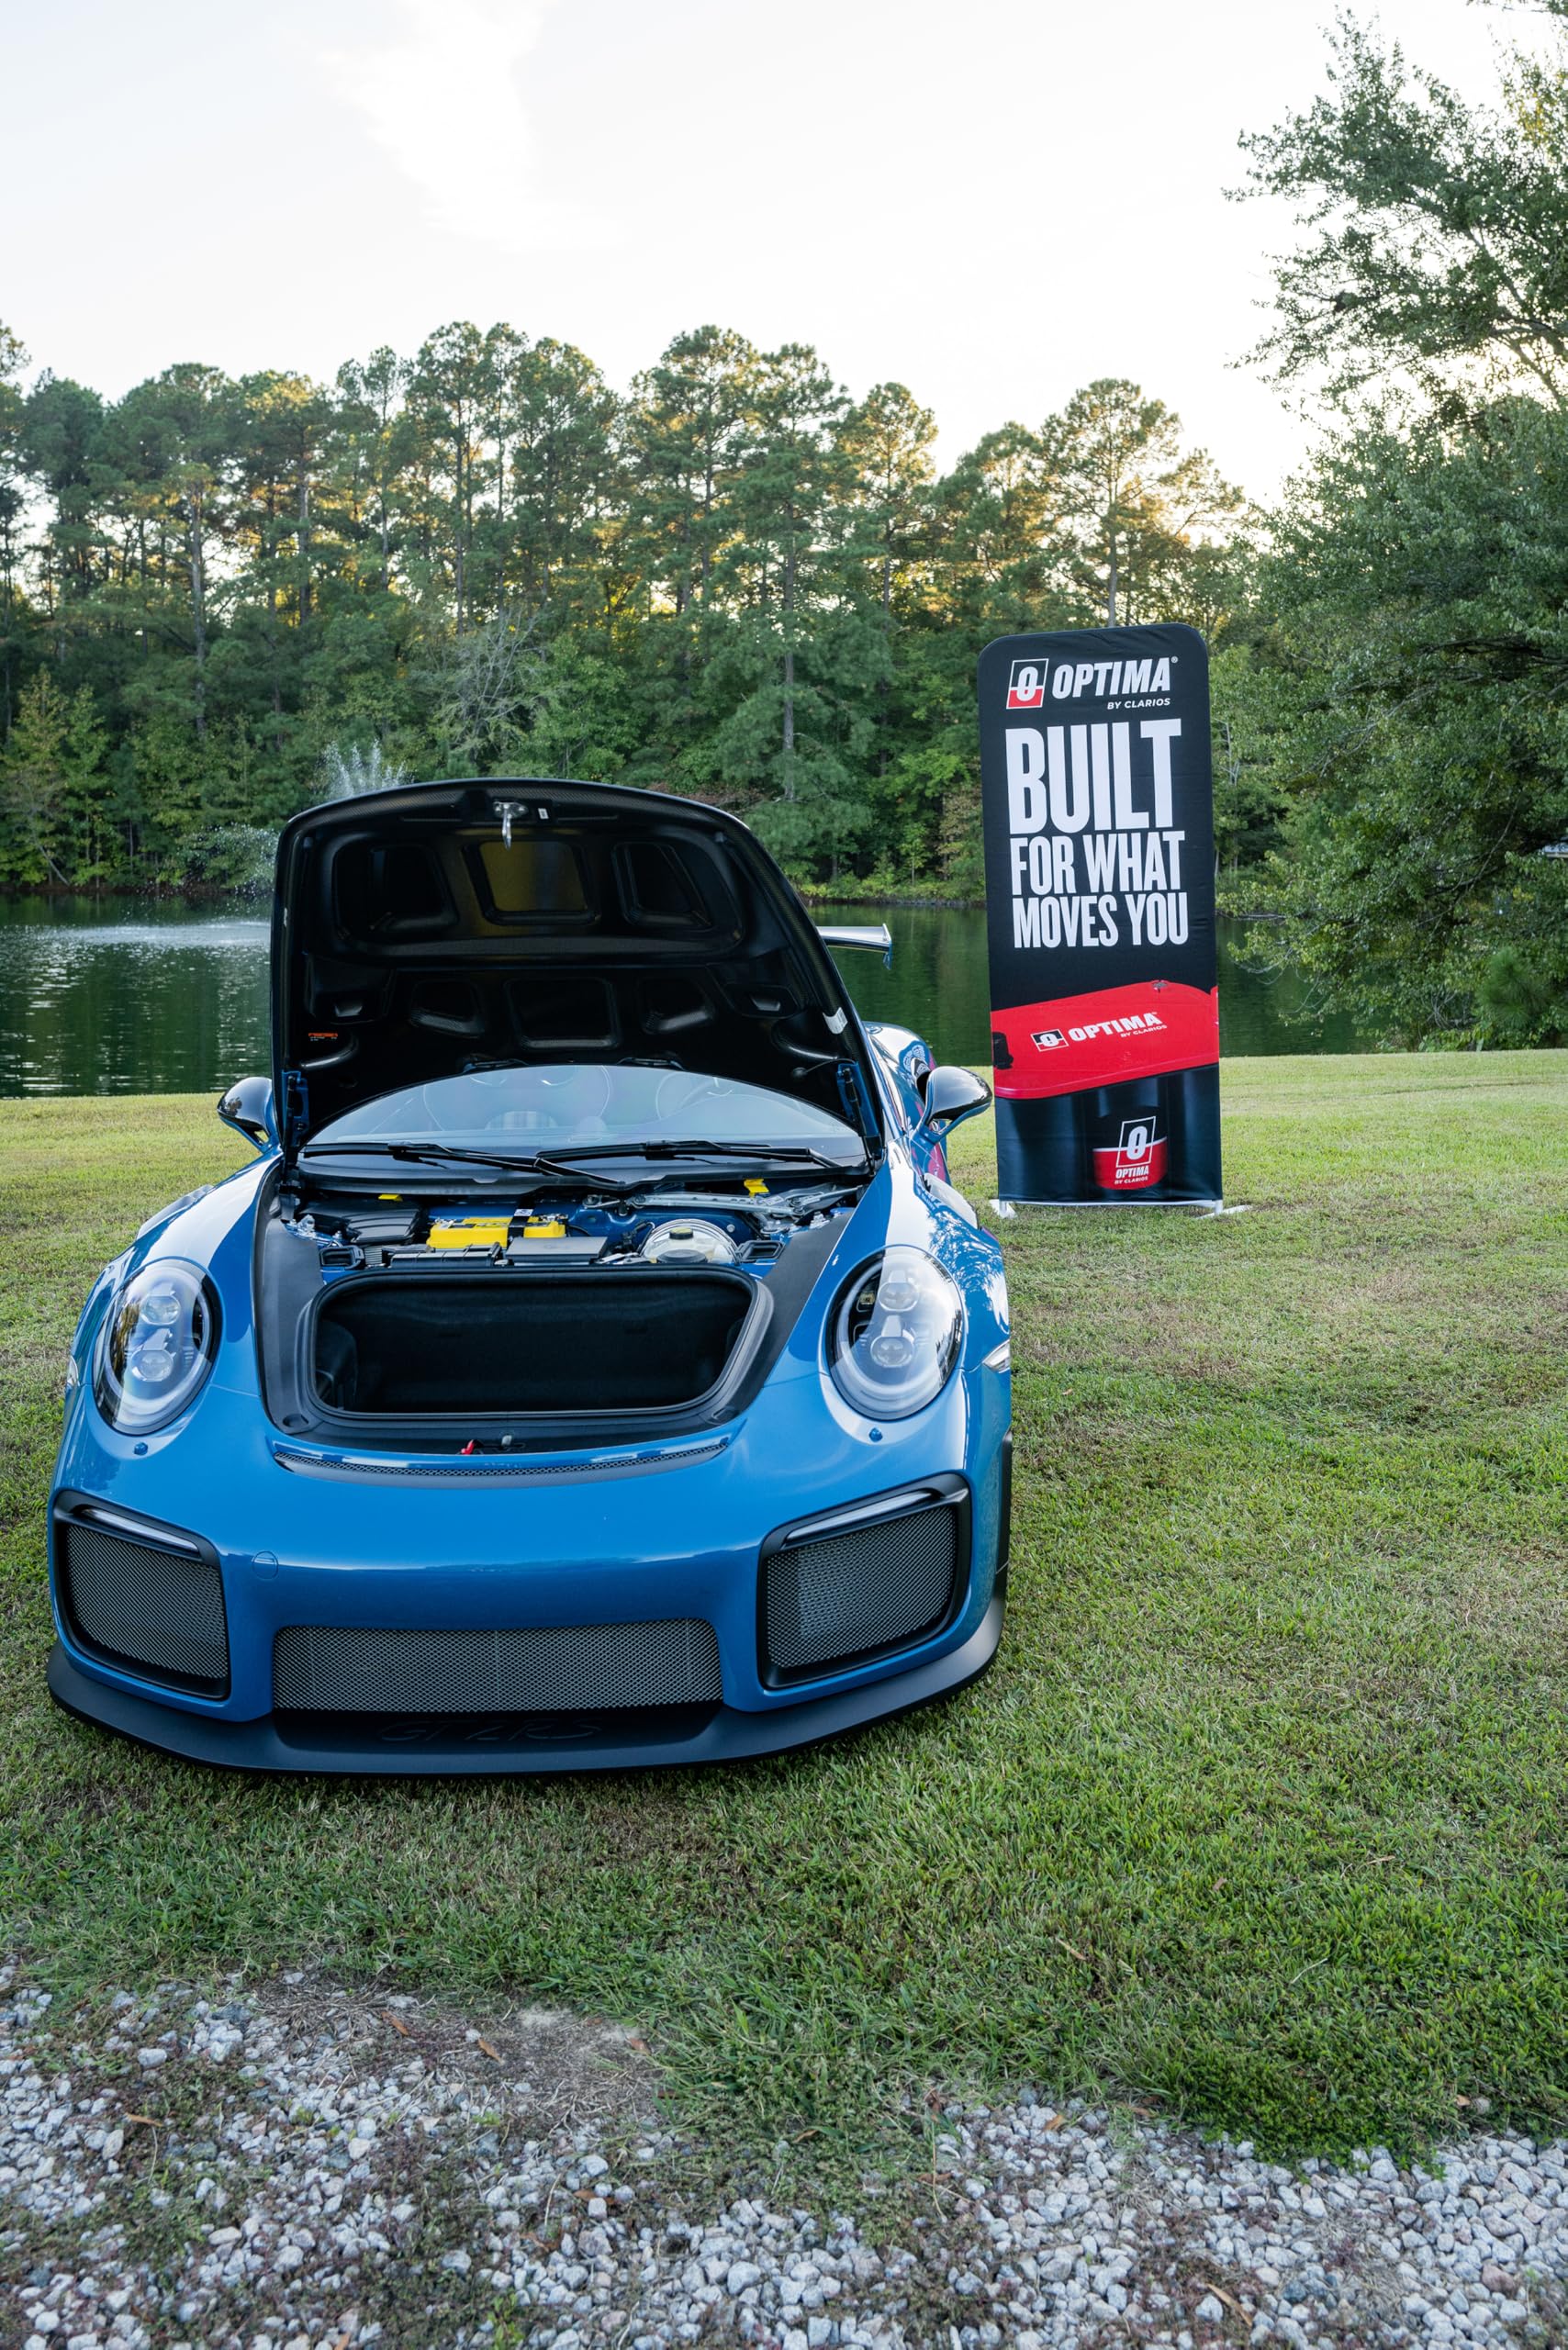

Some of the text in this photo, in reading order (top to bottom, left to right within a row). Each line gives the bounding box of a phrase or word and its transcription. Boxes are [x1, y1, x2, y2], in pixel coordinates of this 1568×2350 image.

[1107, 698, 1171, 710] BY CLARIOS
[1005, 718, 1182, 834] BUILT
[1010, 830, 1185, 896] FOR WHAT
[1012, 892, 1189, 949] MOVES YOU
[1133, 1024, 1168, 1035] CLARIOS
[1115, 1166, 1149, 1179] OPTIMA
[1124, 1176, 1148, 1184] CLARIOS
